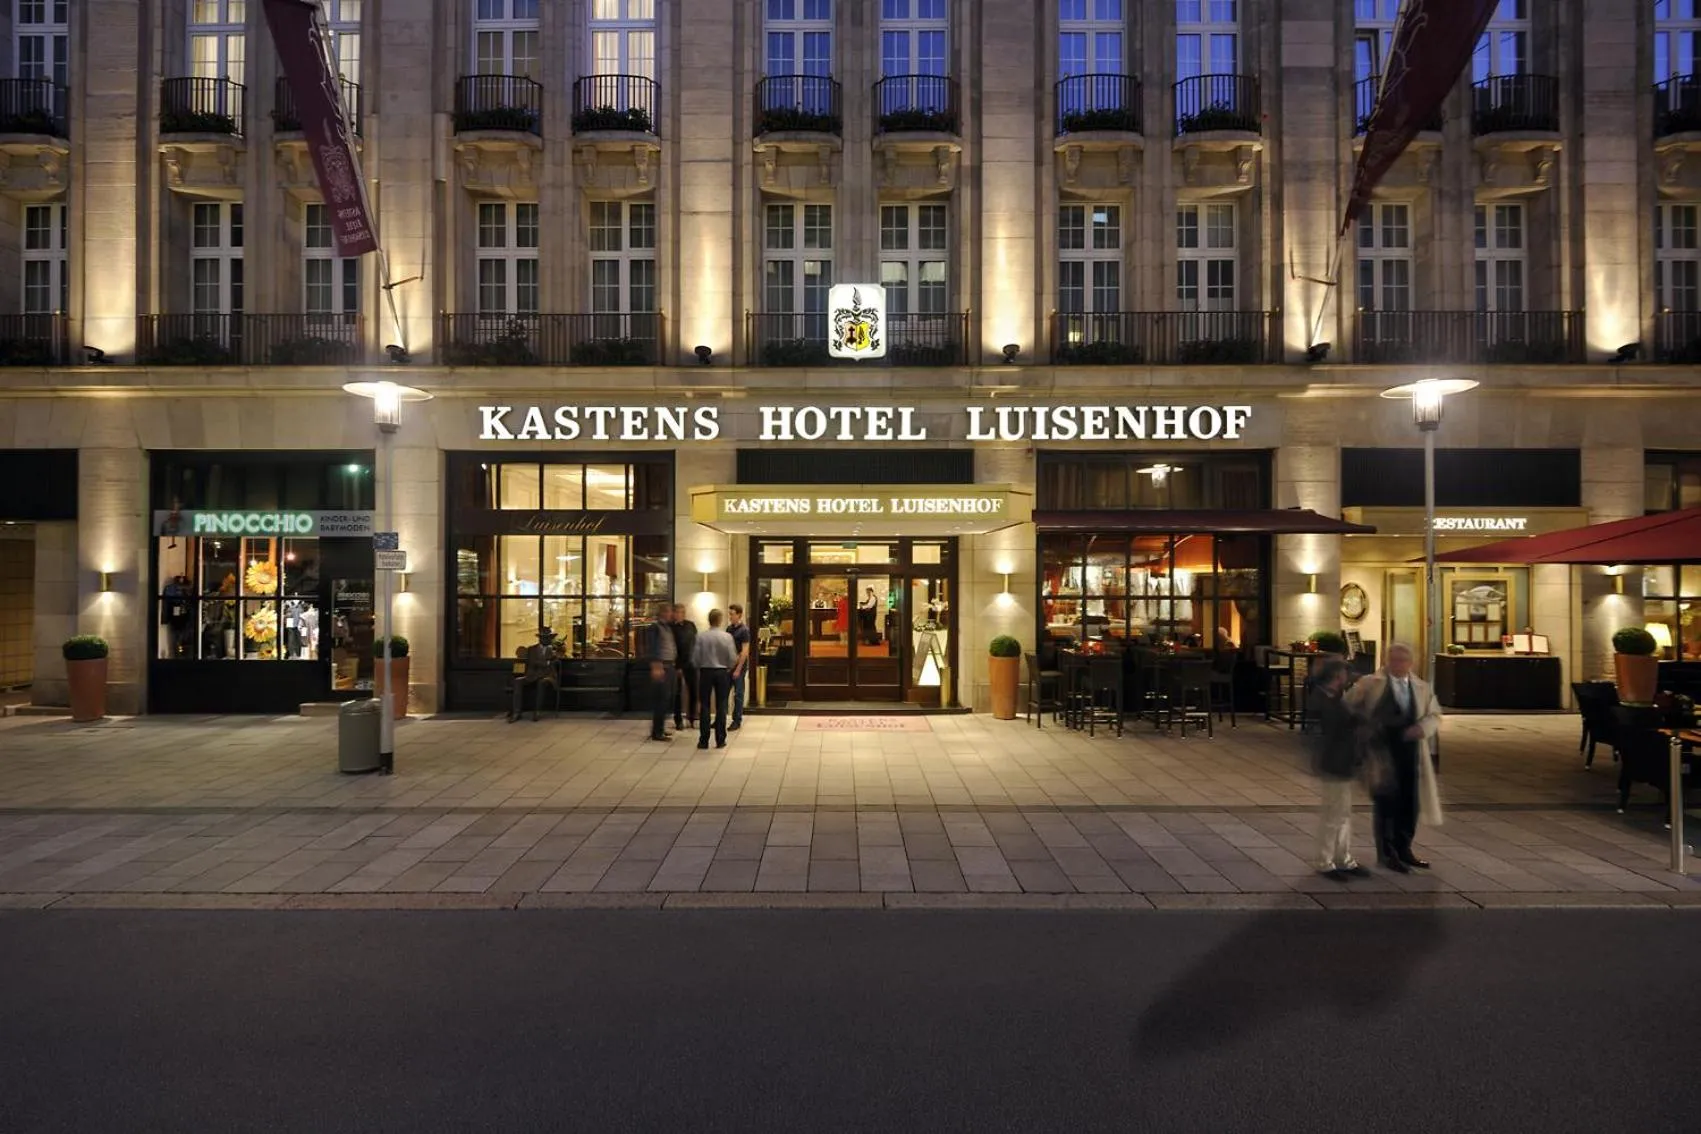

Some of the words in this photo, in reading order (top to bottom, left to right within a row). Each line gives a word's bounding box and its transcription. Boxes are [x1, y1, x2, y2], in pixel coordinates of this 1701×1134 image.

[478, 405, 720, 441] KASTENS
[759, 405, 928, 441] HOTEL
[966, 405, 1252, 441] LUISENHOF
[723, 498, 811, 514] KASTENS
[816, 498, 884, 513] HOTEL
[890, 498, 1003, 514] LUISENHOF
[193, 513, 313, 534] PINOCCHIO
[518, 513, 607, 533] Luisenhof
